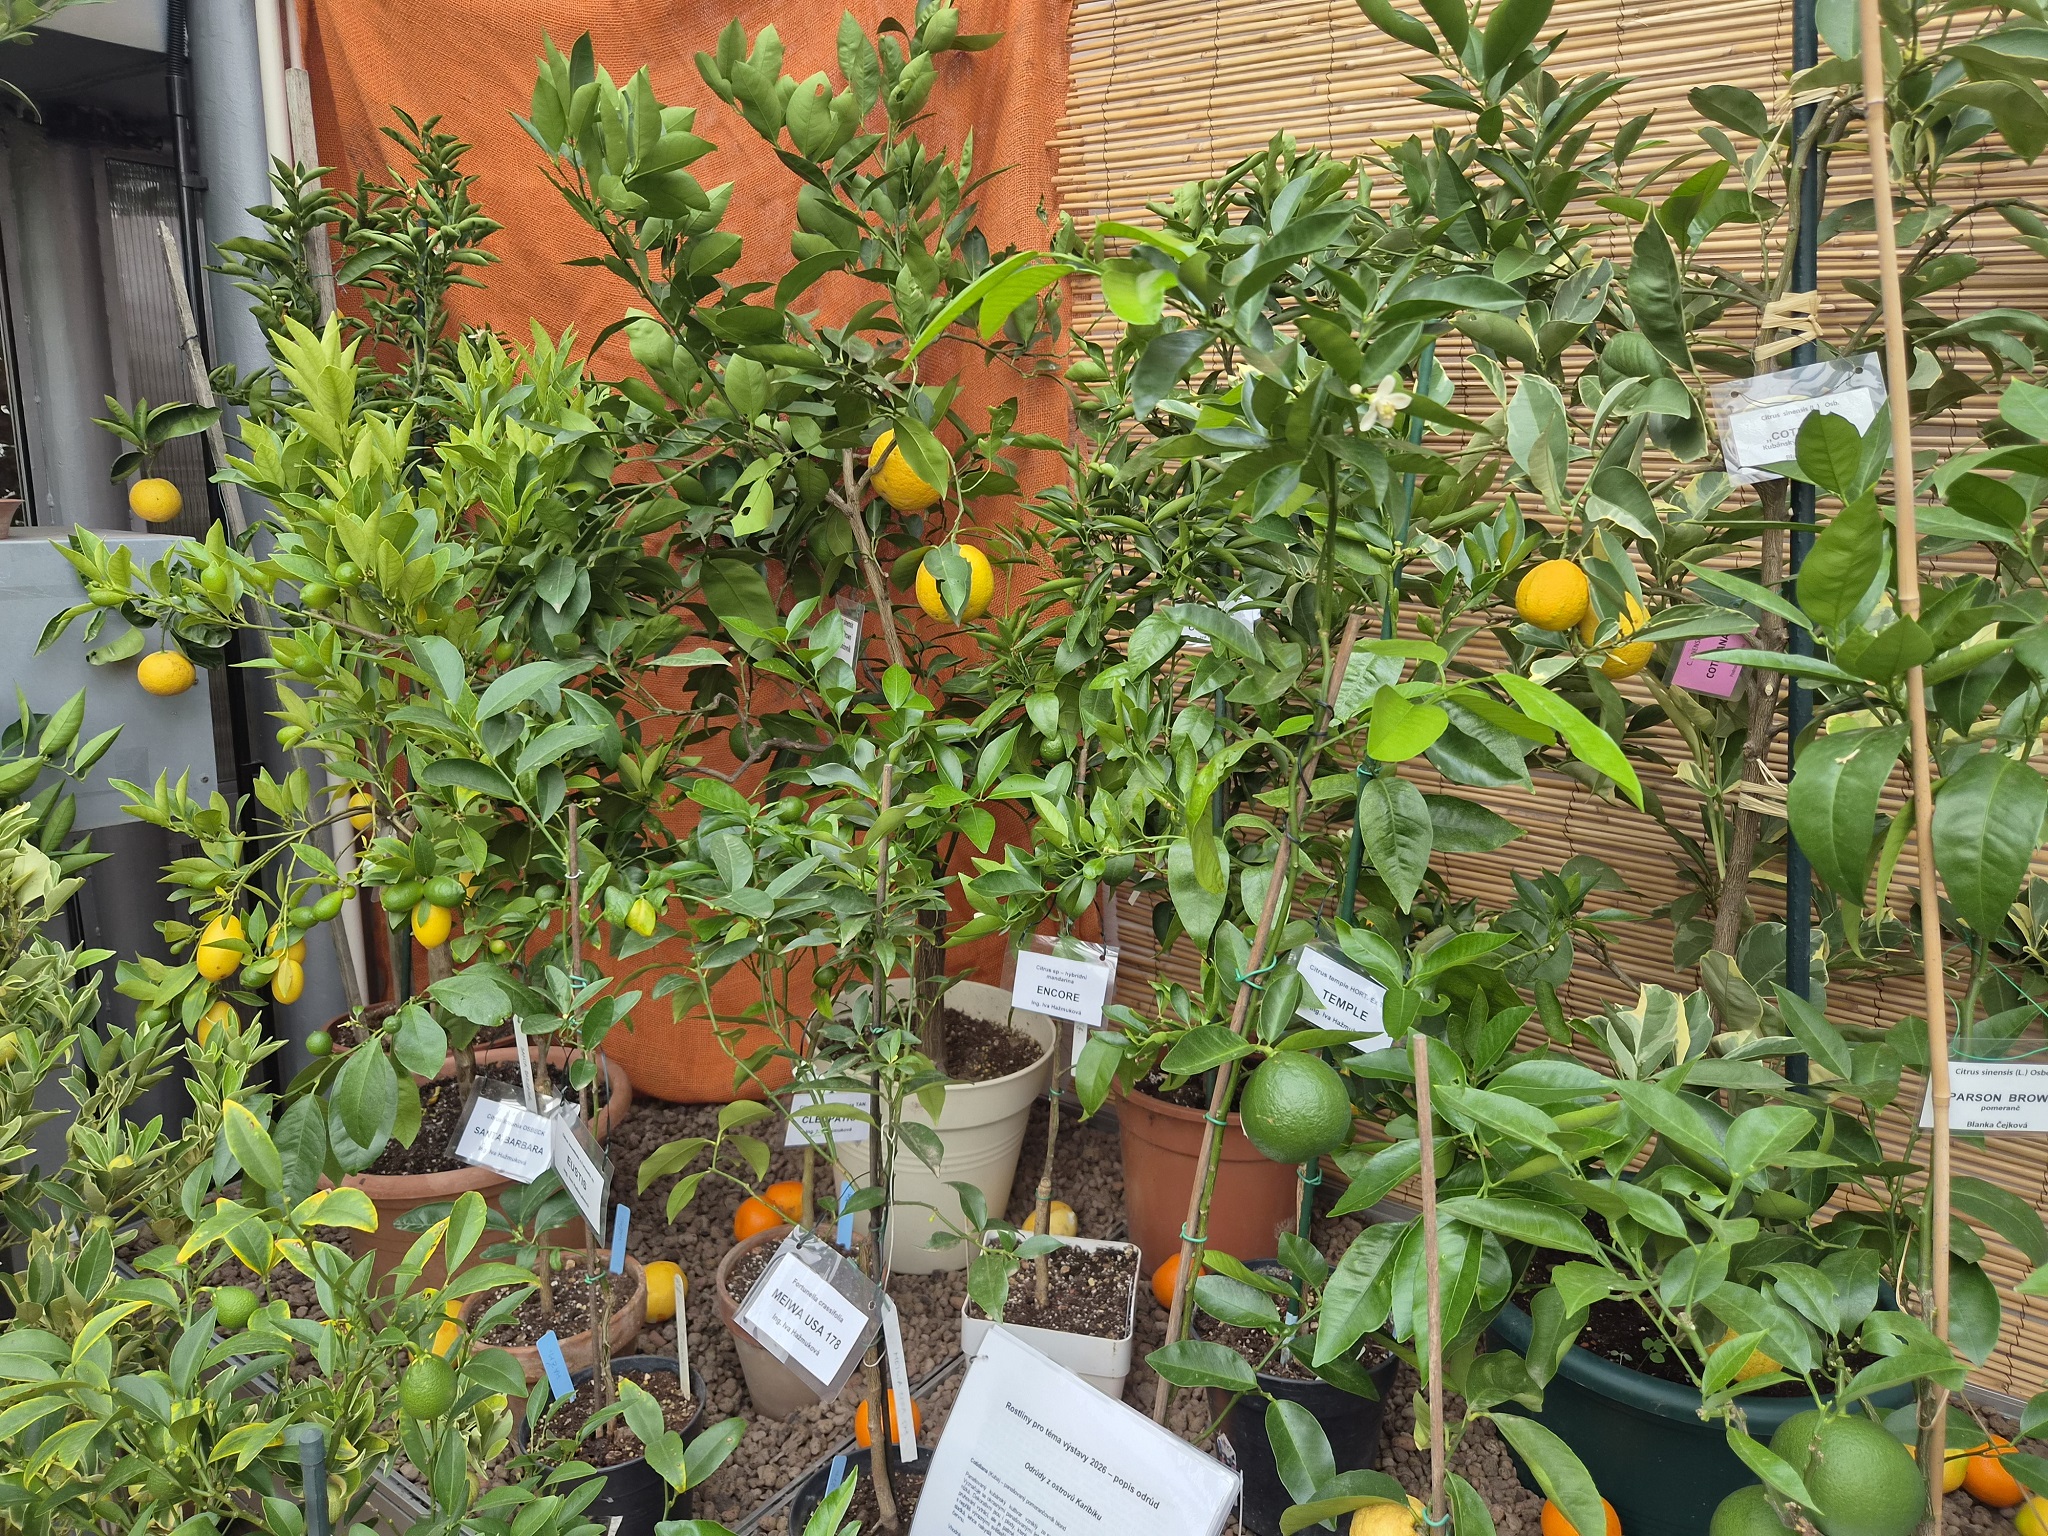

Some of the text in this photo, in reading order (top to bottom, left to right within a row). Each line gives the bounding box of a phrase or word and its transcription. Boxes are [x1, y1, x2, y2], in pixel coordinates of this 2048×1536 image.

[1761, 413, 1780, 421] Citrus
[1783, 406, 1808, 416] sinensis
[1824, 400, 1839, 408] Osb.
[1036, 964, 1052, 973] Citrus
[1065, 971, 1088, 980] hybridní
[1046, 975, 1074, 984] mandarina
[1309, 964, 1328, 978] Citrus
[1328, 975, 1348, 990] temple
[1350, 986, 1368, 1000] HORT.
[1031, 1000, 1041, 1008] Ing.
[1036, 986, 1080, 1002] ENCORE
[1322, 989, 1368, 1022] TEMPLE
[1310, 1008, 1320, 1016] ng.
[1322, 1012, 1331, 1020] Iva
[1956, 1068, 1980, 1076] Citrus
[1982, 1068, 2013, 1076] sinensis
[2016, 1068, 2028, 1076] (L.)
[1996, 1120, 2028, 1129] Čejková
[474, 1126, 544, 1155] SANTA BARBARA
[566, 1155, 586, 1191] EUSTIS
[792, 1278, 844, 1324] Fortunella crassifolia
[771, 1288, 842, 1350] MEIWA USA 178
[771, 1313, 821, 1356] Ing. Iva Hažmuková
[1005, 1401, 1032, 1425] Rostliny
[1032, 1421, 1044, 1432] pro
[1045, 1428, 1062, 1444] téma
[1063, 1440, 1089, 1463] výstavy
[1090, 1458, 1108, 1474] 2026
[1112, 1476, 1135, 1494] popis
[1136, 1490, 1160, 1510] odrůd
[1024, 1462, 1046, 1482] Odrůdy
[1052, 1482, 1076, 1502] ostrovů
[1075, 1498, 1102, 1521] Karibiku
